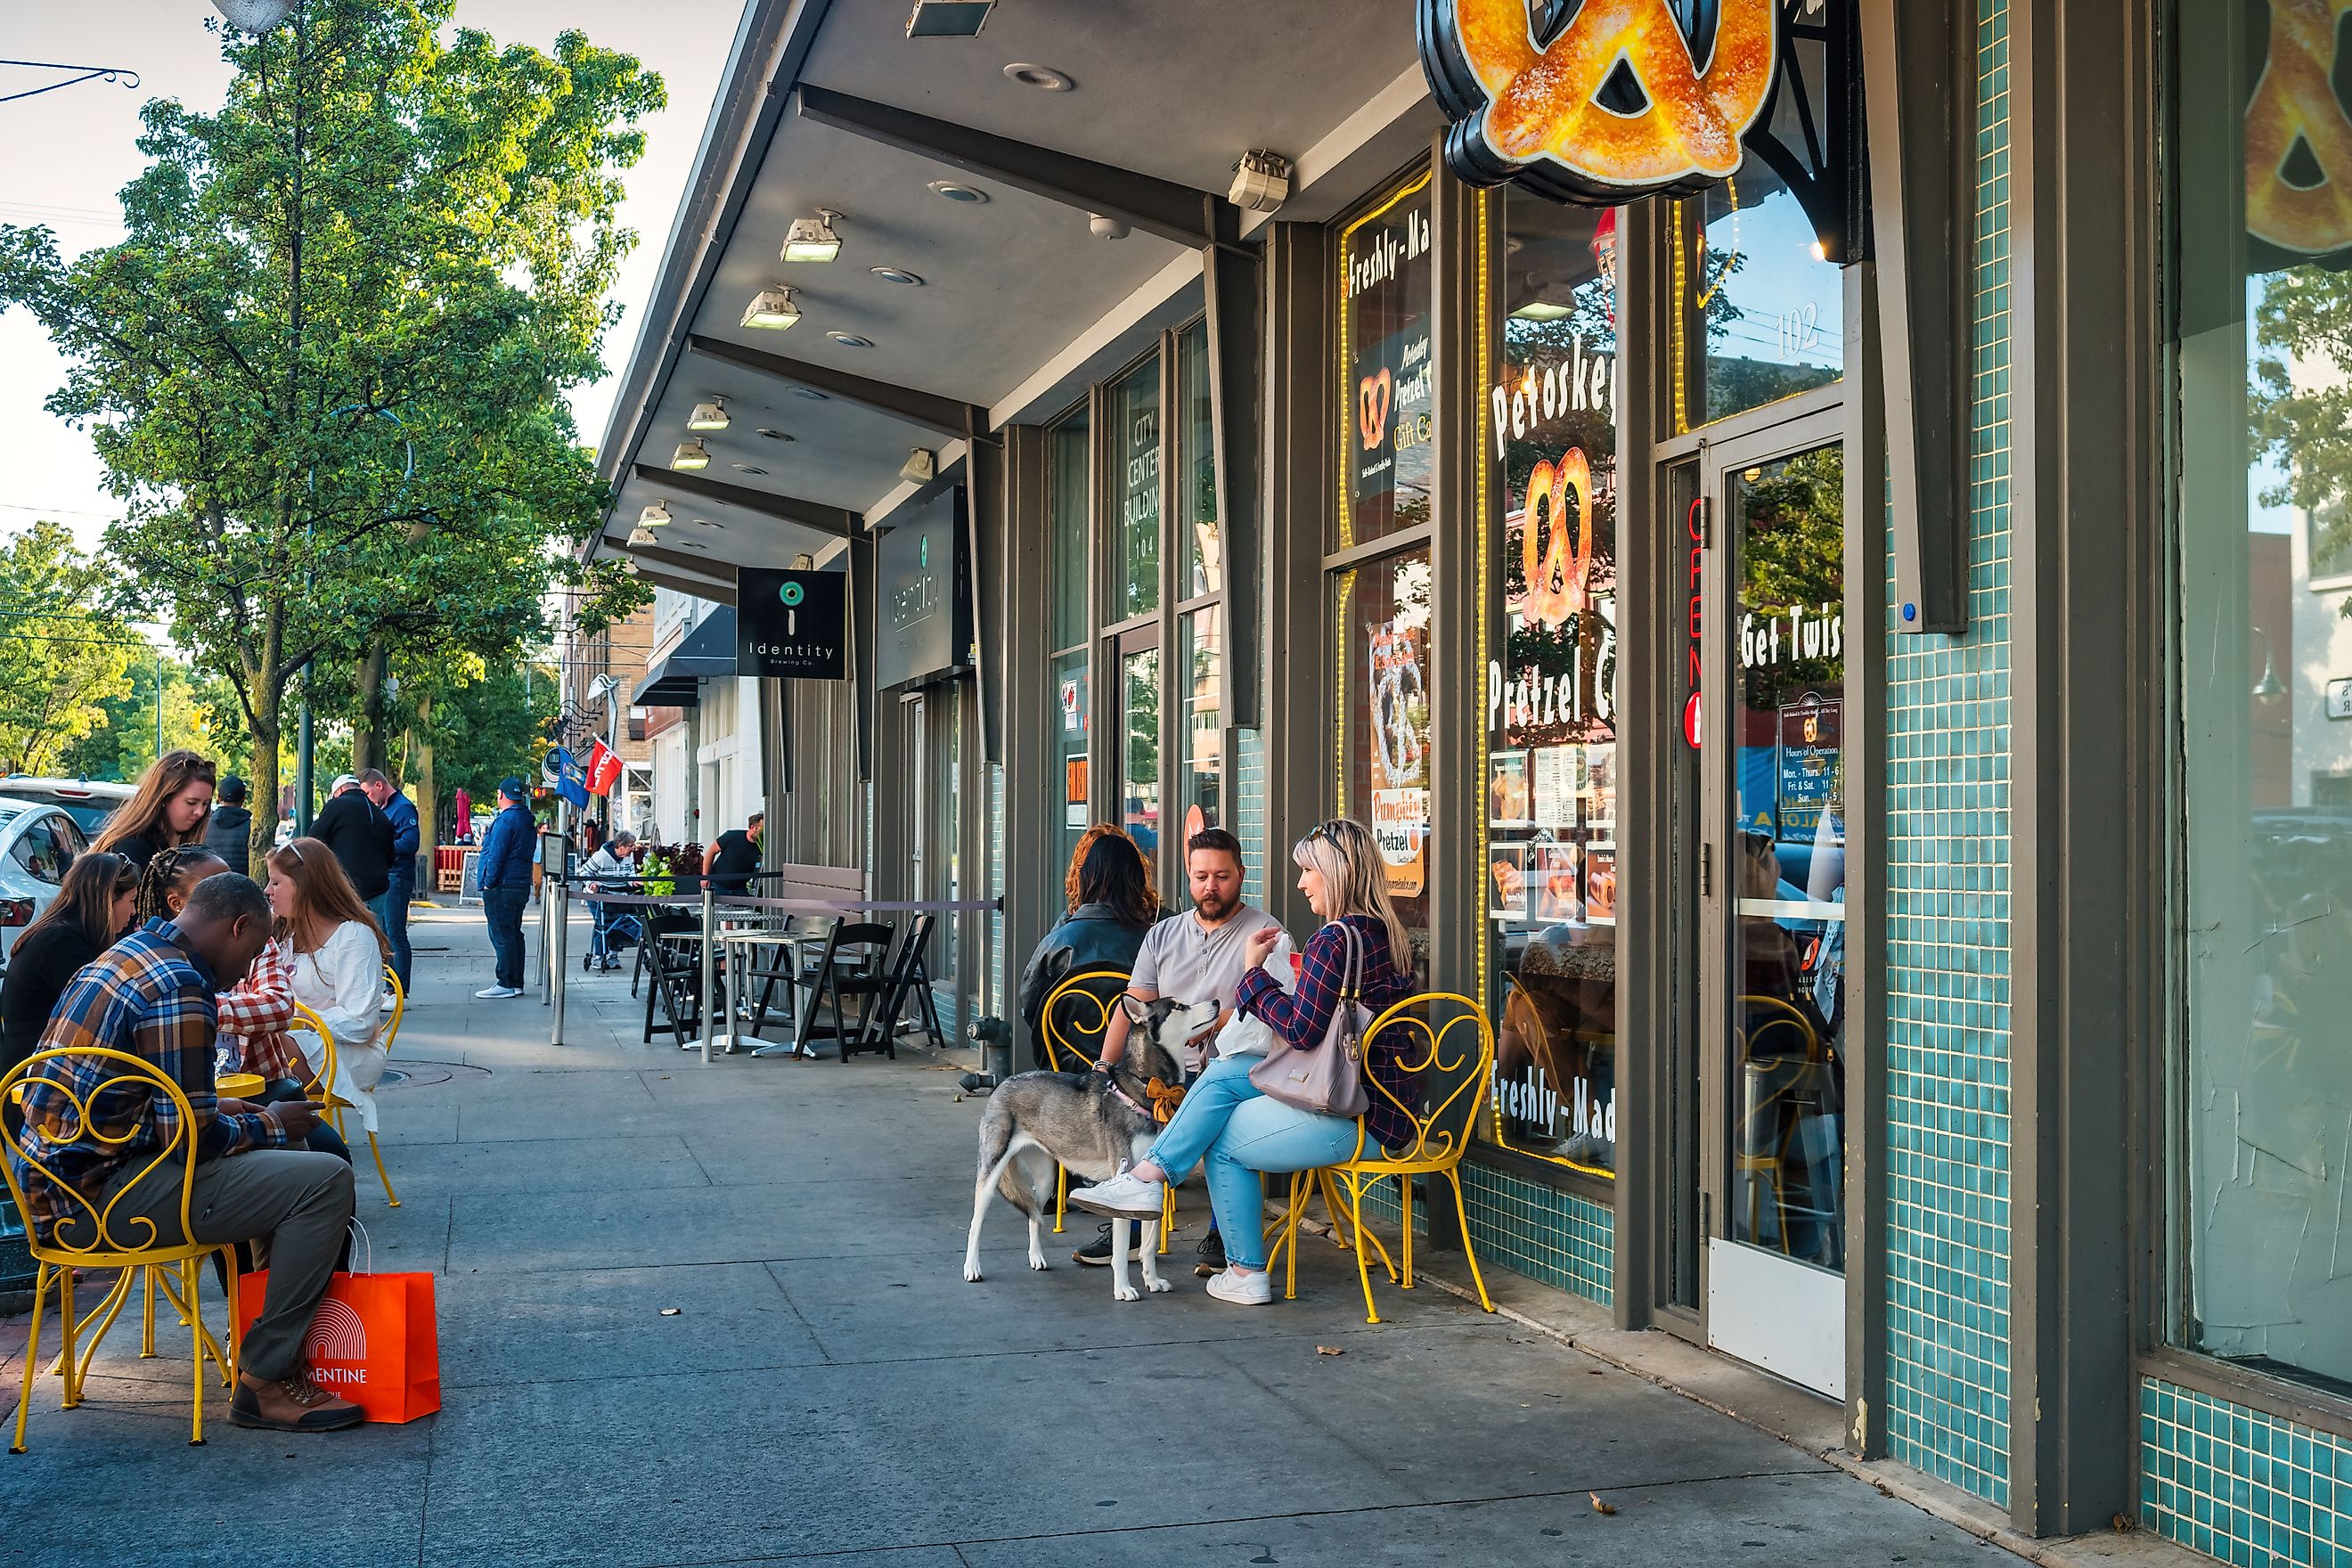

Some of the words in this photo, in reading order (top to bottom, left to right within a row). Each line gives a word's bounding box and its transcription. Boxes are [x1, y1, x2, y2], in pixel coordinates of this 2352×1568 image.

[1349, 208, 1429, 298] Freshly-Ma
[1775, 301, 1818, 360] 102
[1394, 363, 1425, 412] Pretzel
[1134, 411, 1155, 446] CITY
[1394, 422, 1416, 452] Gift
[1128, 446, 1160, 487] CENTER
[1135, 535, 1153, 559] 104
[749, 642, 833, 659] Identity
[1741, 613, 1779, 668] Get
[1790, 601, 1841, 661] Twis
[1489, 645, 1580, 731] Pretzel
[1786, 747, 1802, 757] Hours
[1803, 745, 1809, 755] of
[1809, 745, 1838, 757] Operation
[1784, 769, 1797, 778] Mon.
[1801, 768, 1820, 778] Thurs.
[1824, 766, 1830, 776] 11
[1834, 766, 1839, 776] 6
[1788, 781, 1797, 791] Fri.
[1798, 780, 1802, 790] &
[1803, 780, 1815, 790] Sat.
[1822, 780, 1829, 788] 11
[1833, 780, 1838, 788] 7
[1374, 791, 1420, 829] Pumpkin
[1798, 793, 1811, 803] Sun.
[1822, 792, 1828, 801] 11
[1833, 792, 1837, 801] 5
[1377, 829, 1408, 852] Pretzel
[1490, 1059, 1615, 1143] Freshly-Mad
[305, 1368, 367, 1384] MENTINE
